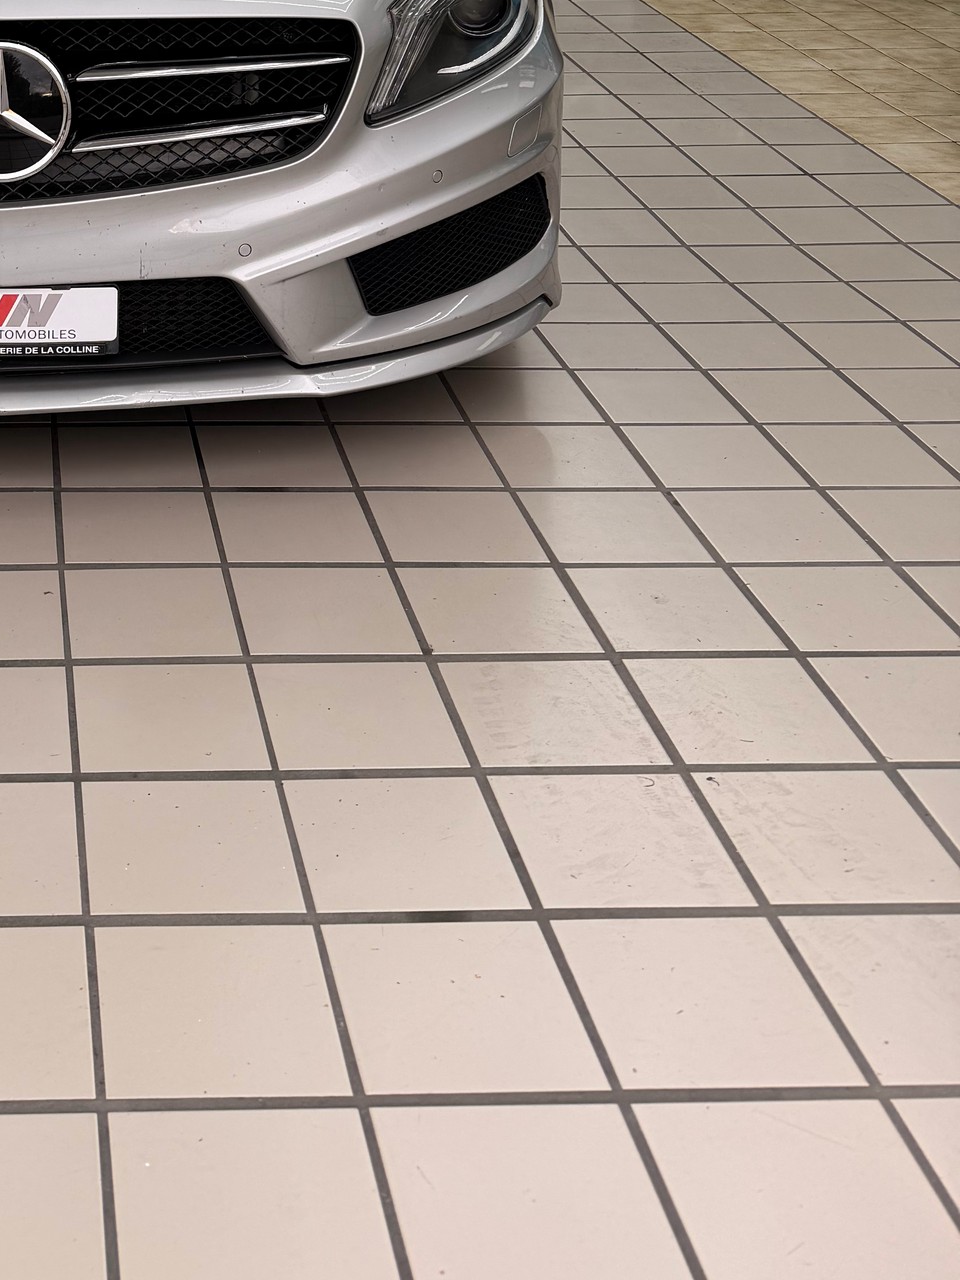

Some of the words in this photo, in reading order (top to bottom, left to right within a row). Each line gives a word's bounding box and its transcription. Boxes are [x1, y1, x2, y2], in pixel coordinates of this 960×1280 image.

[24, 346, 39, 355] DE
[40, 346, 55, 355] LA
[55, 345, 99, 355] COLLINE
